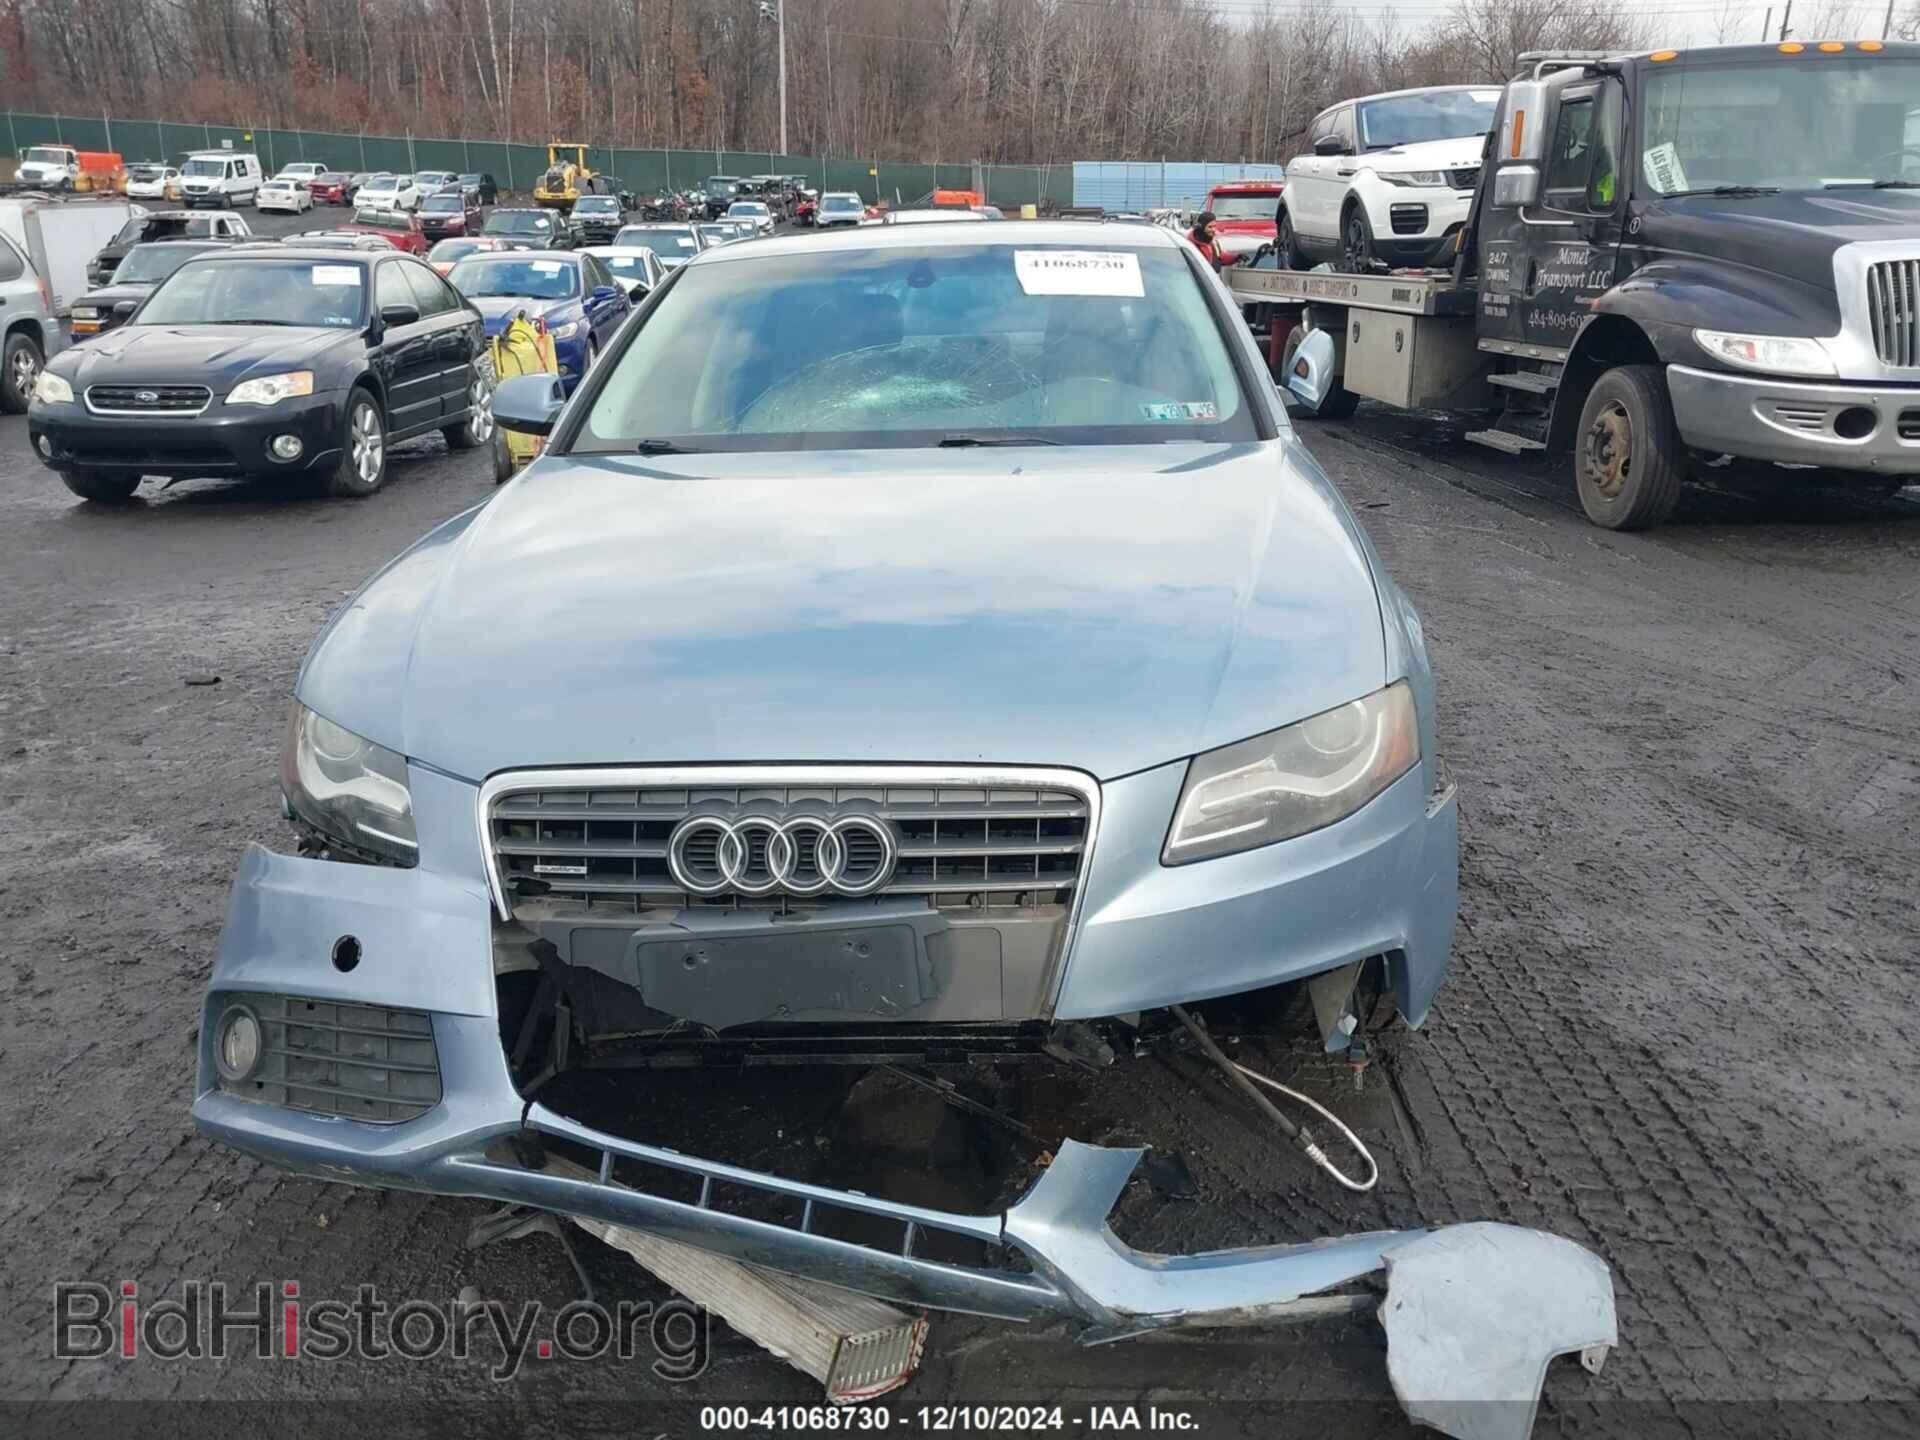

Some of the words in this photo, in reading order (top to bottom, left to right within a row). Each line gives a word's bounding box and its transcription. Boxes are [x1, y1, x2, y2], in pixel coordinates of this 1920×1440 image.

[1488, 251, 1508, 265] 24/7
[1556, 247, 1590, 265] Monet
[1536, 269, 1585, 293] Transport
[1586, 269, 1612, 289] LLC
[1528, 308, 1583, 330] 484-809-60
